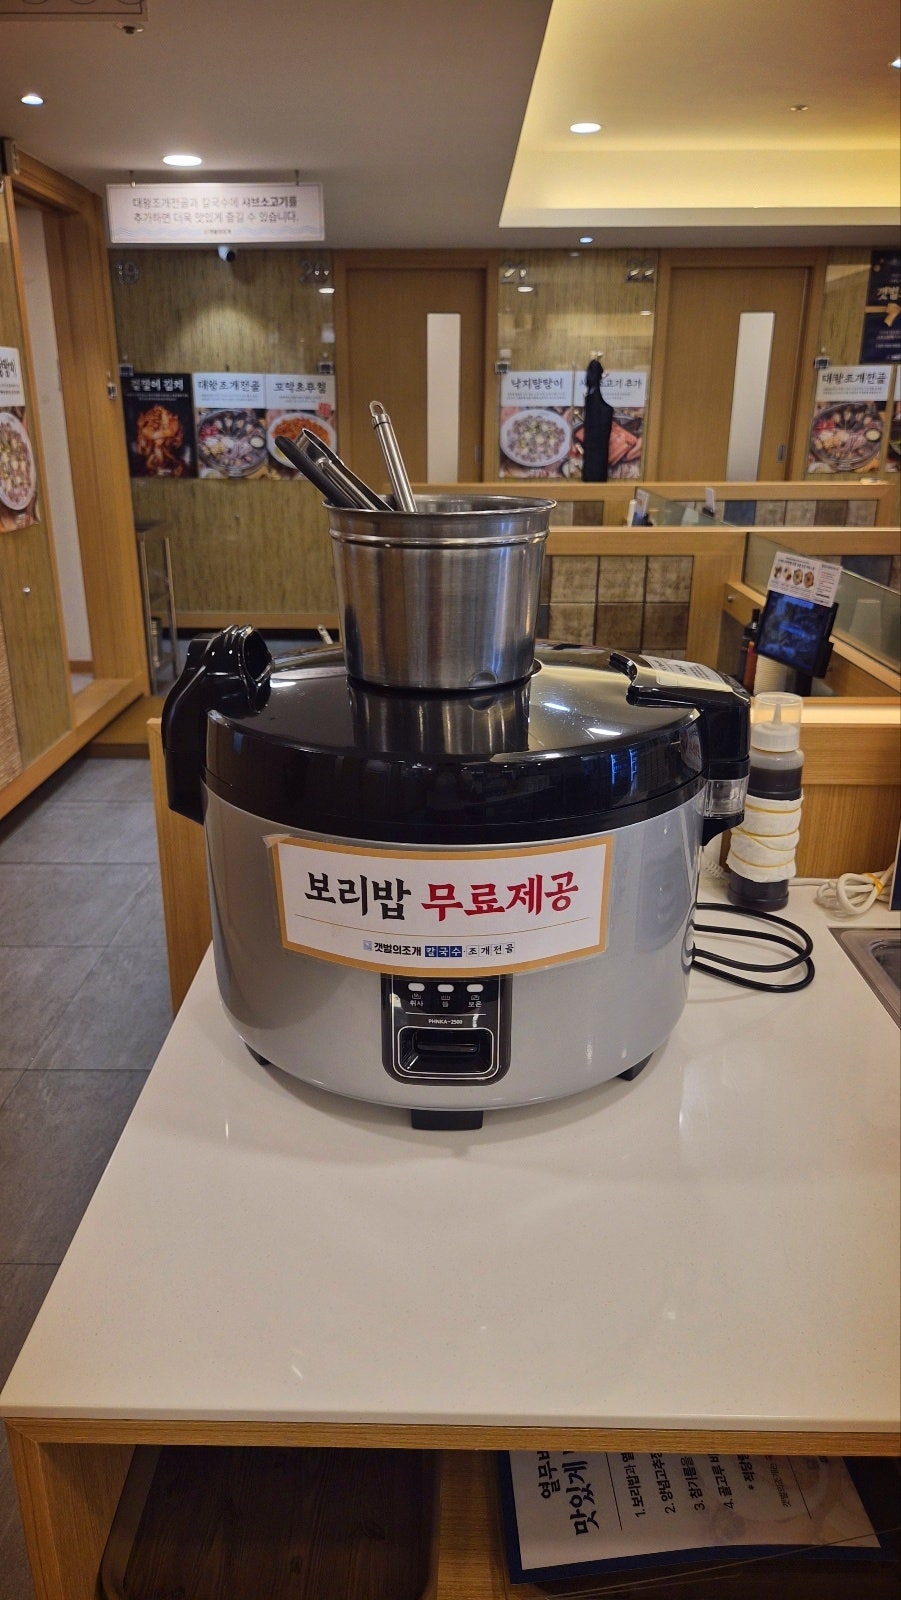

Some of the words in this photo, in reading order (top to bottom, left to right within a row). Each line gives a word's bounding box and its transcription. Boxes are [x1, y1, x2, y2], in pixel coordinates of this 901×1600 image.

[242, 196, 297, 208] 샤브소고기를
[304, 871, 411, 921] 보리밥
[421, 871, 579, 921] 무료제공
[374, 942, 422, 956] 갯벌의조개
[680, 1456, 704, 1499] 참기름을
[711, 1464, 733, 1498] 골고루
[562, 1461, 600, 1535] 맛있게
